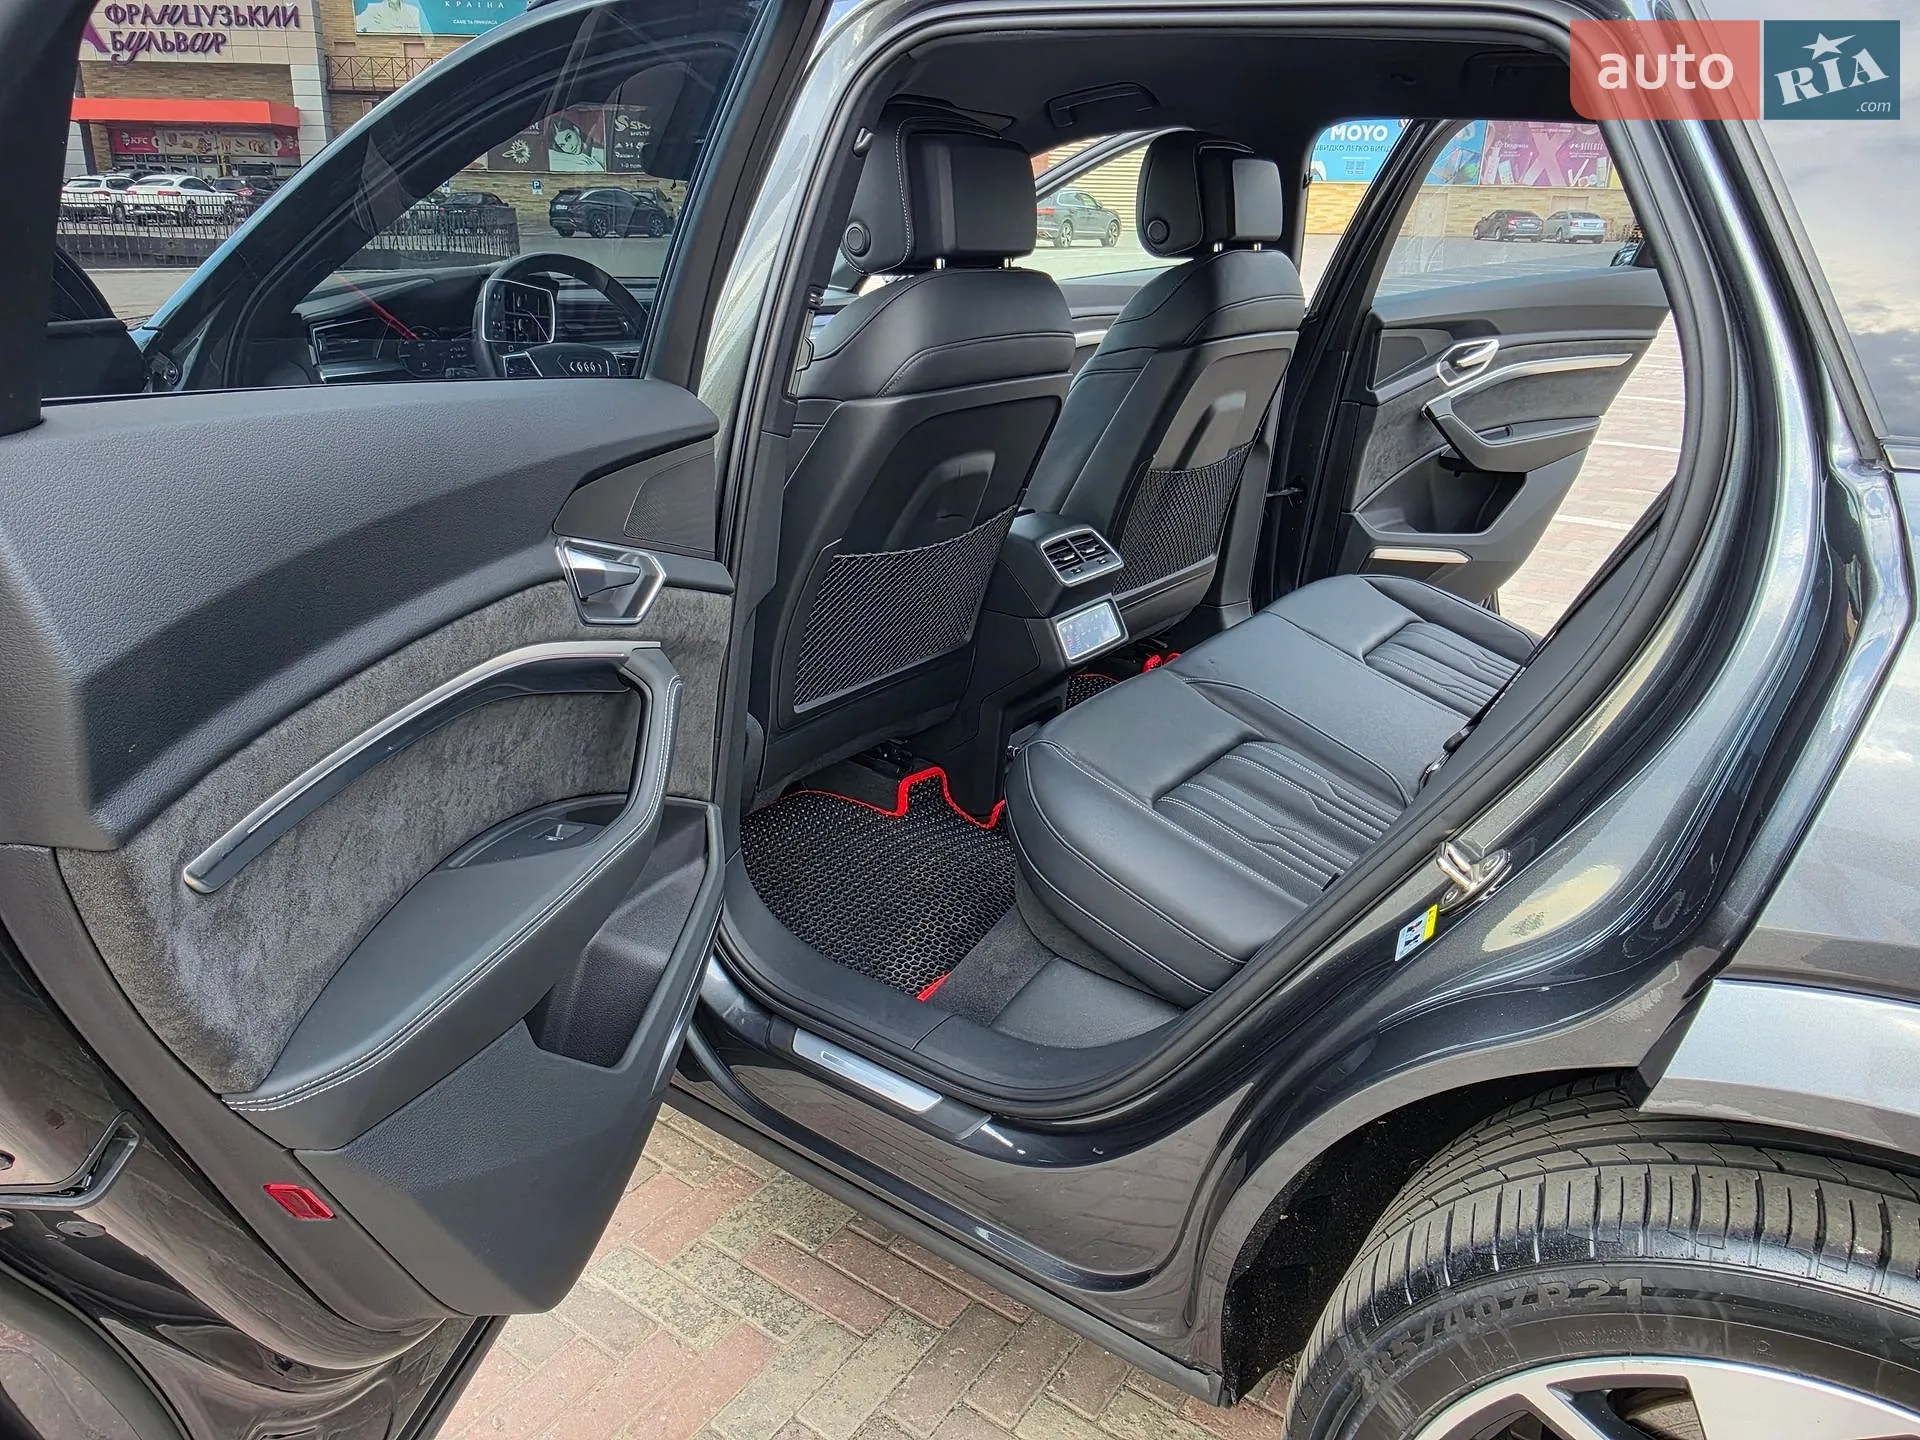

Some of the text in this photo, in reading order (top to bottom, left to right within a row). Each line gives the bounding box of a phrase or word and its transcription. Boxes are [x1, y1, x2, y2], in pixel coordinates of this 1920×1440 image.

[104, 1, 300, 28] ФРАНЦУЗЬКИЙ
[131, 136, 148, 145] KFC
[1330, 124, 1389, 142] MOYO
